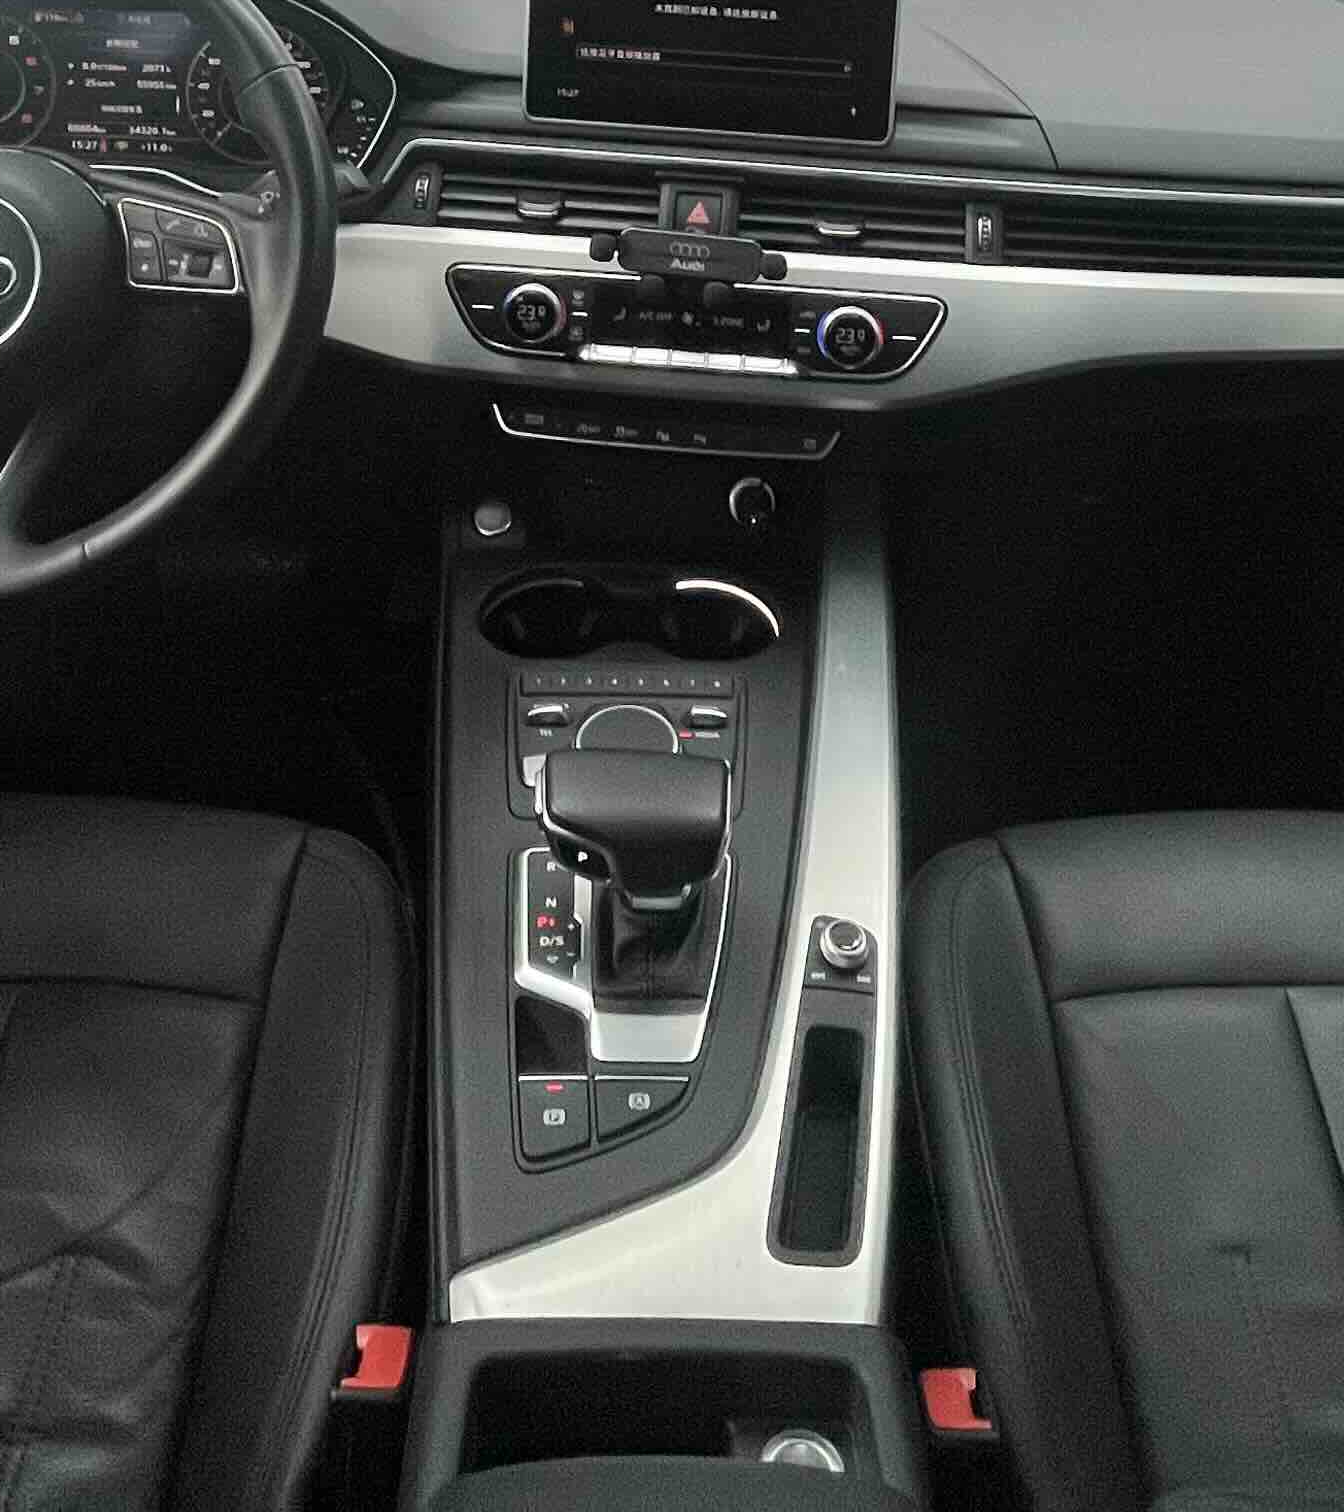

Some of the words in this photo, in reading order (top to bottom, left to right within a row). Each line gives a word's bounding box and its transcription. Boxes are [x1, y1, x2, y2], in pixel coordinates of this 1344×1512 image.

[671, 257, 705, 272] Audi
[577, 851, 588, 862] P
[546, 861, 556, 872] R
[545, 896, 557, 908] N
[539, 935, 565, 947] D/S
